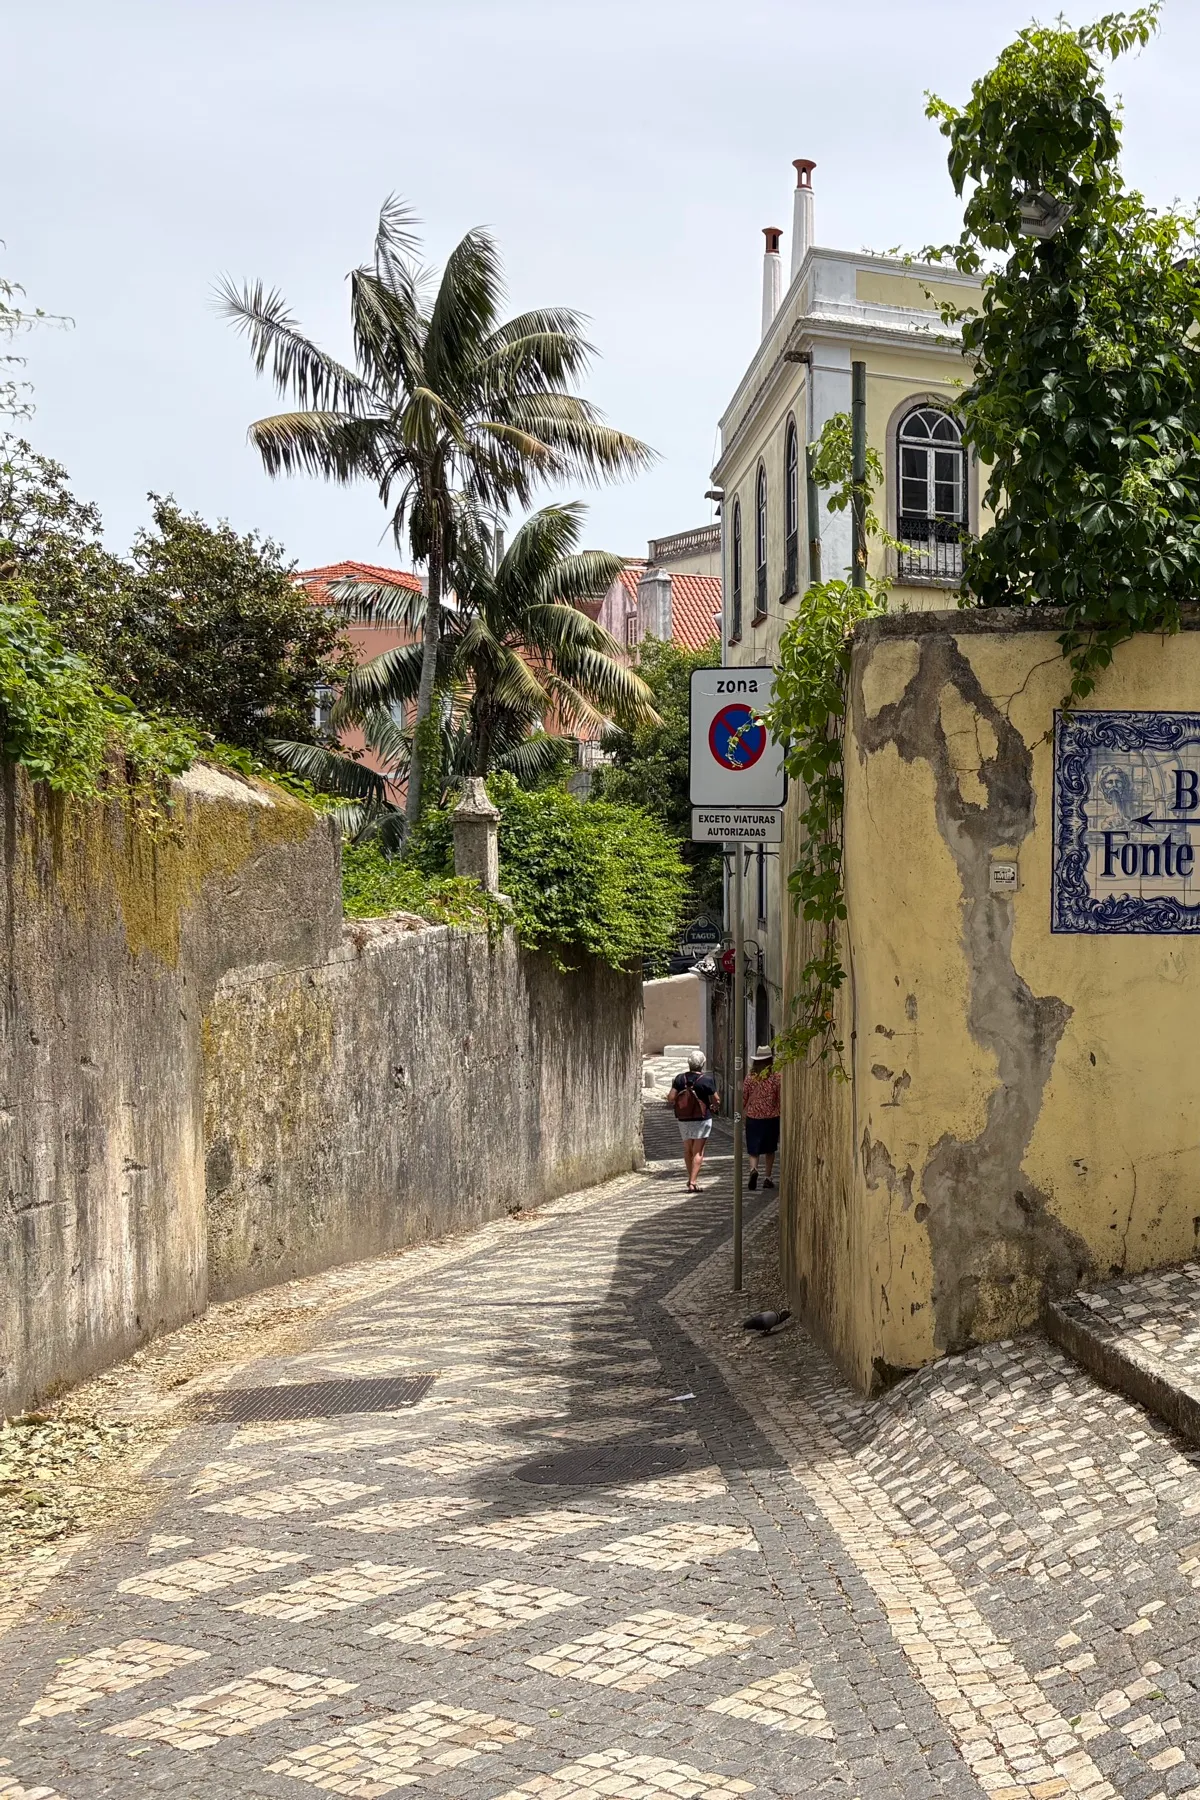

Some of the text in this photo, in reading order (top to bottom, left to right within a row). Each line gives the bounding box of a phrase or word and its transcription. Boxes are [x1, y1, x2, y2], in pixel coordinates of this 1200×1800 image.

[716, 680, 758, 693] zona
[698, 814, 776, 824] EXCETO VIATURAS
[707, 827, 766, 837] AUTORIZADAS
[1100, 831, 1194, 877] Fonte
[690, 932, 716, 940] TAGUS
